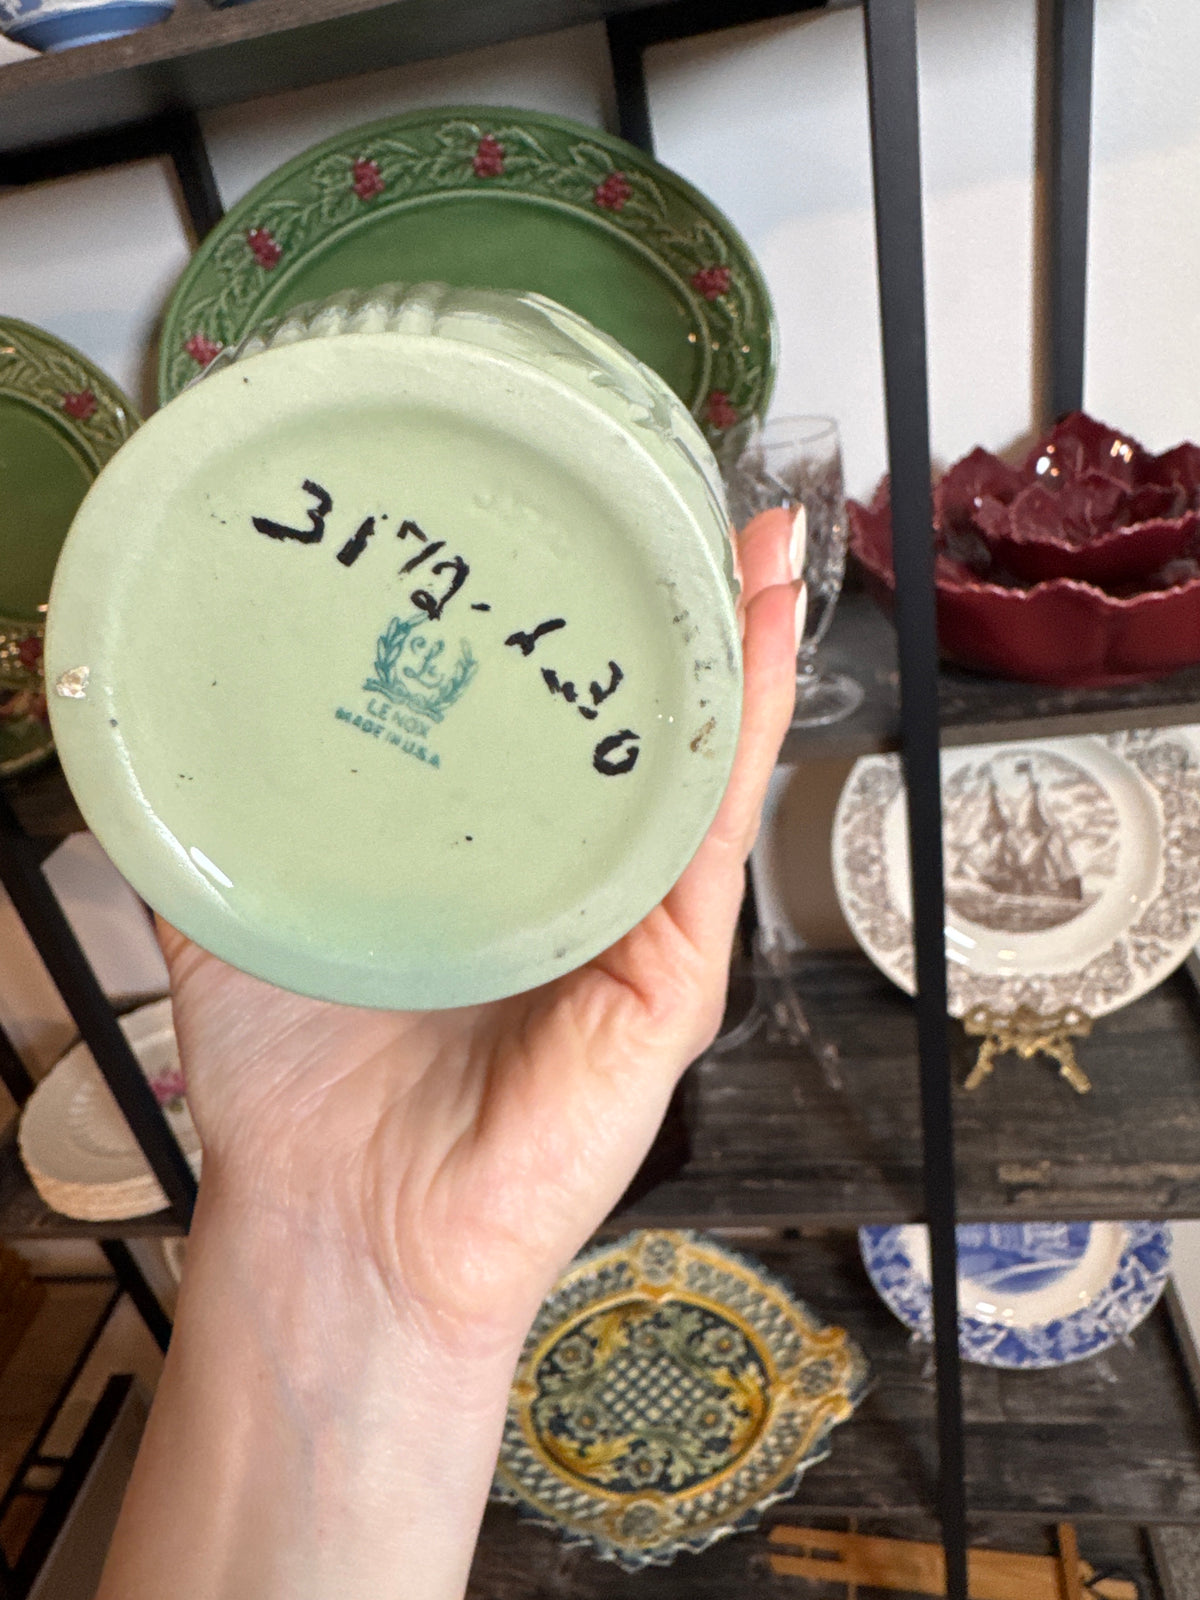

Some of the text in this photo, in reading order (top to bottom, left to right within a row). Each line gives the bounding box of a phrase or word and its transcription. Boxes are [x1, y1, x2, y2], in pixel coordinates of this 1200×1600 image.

[335, 706, 386, 739] MADE
[386, 731, 403, 746] IN
[367, 697, 432, 739] LENOX
